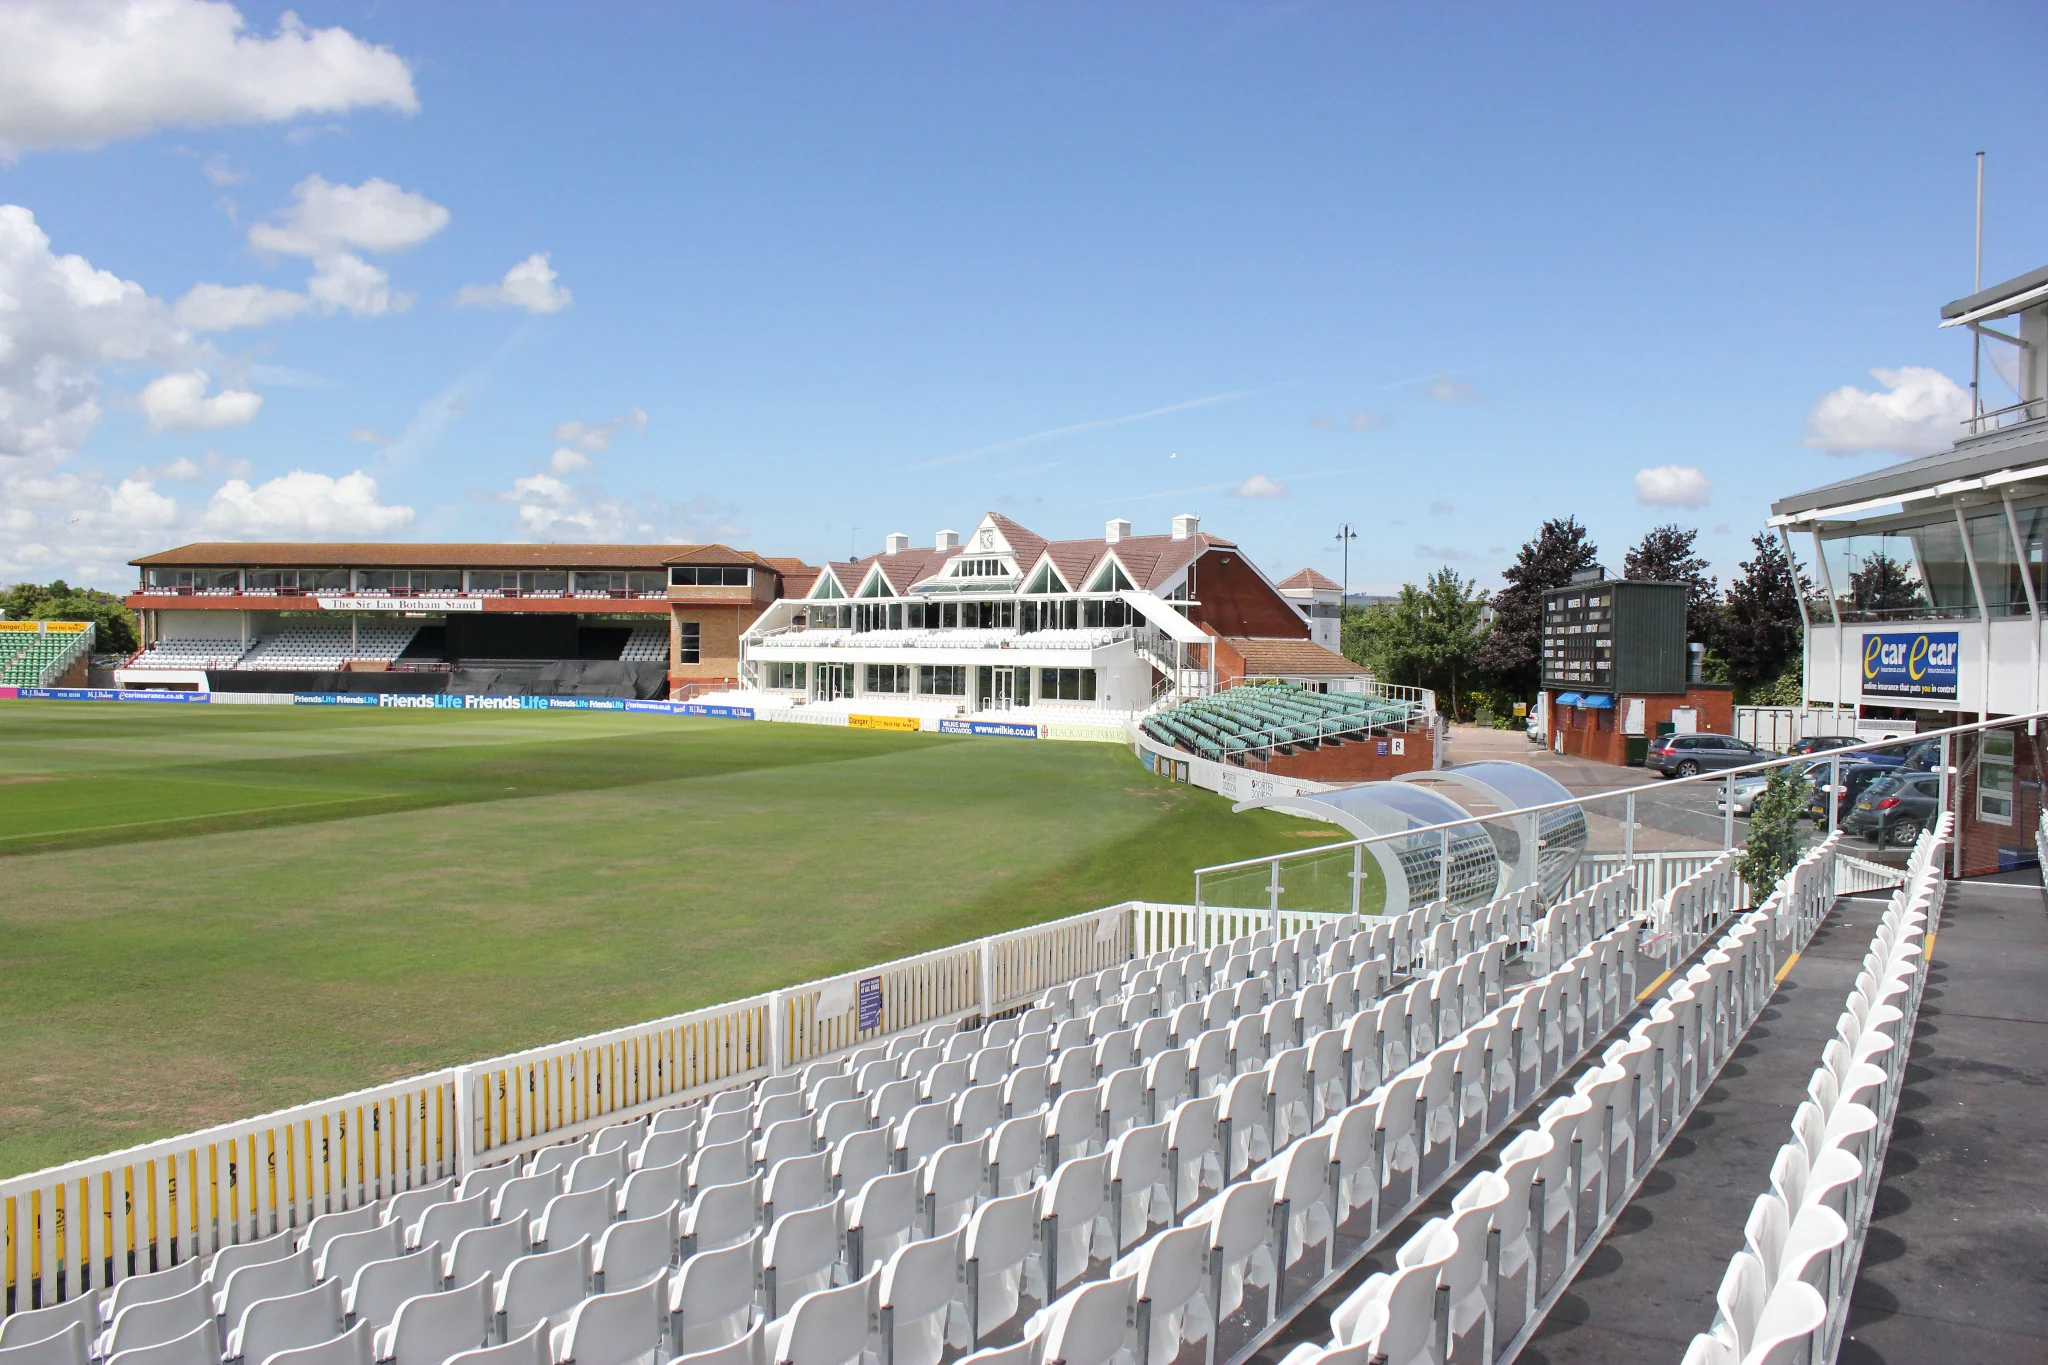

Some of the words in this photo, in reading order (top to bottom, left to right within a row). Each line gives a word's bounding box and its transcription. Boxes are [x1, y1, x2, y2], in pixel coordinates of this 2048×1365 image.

[332, 600, 350, 608] The
[356, 600, 371, 608] Sir
[376, 600, 394, 609] Ian
[399, 600, 440, 609] Botham
[445, 601, 476, 609] Stand
[1881, 643, 1907, 665] car
[1928, 642, 1957, 666] car
[1864, 682, 1877, 690] online
[1878, 682, 1899, 691] insurance
[1899, 683, 1910, 691] that
[1910, 685, 1921, 693] puts
[1921, 686, 1931, 694] you
[1931, 684, 1937, 692] in
[1937, 685, 1956, 694] control
[294, 695, 336, 703] FriendsLife
[336, 696, 378, 704] FriendsLife
[379, 693, 463, 708] FriendsLife
[465, 694, 549, 710] FriendsLife
[550, 698, 589, 708] FriendsLife
[589, 700, 624, 709] FriendsLife
[849, 716, 869, 726] Danger
[974, 725, 1036, 737] www.wilkie.co.uk
[1255, 780, 1274, 792] PORTER
